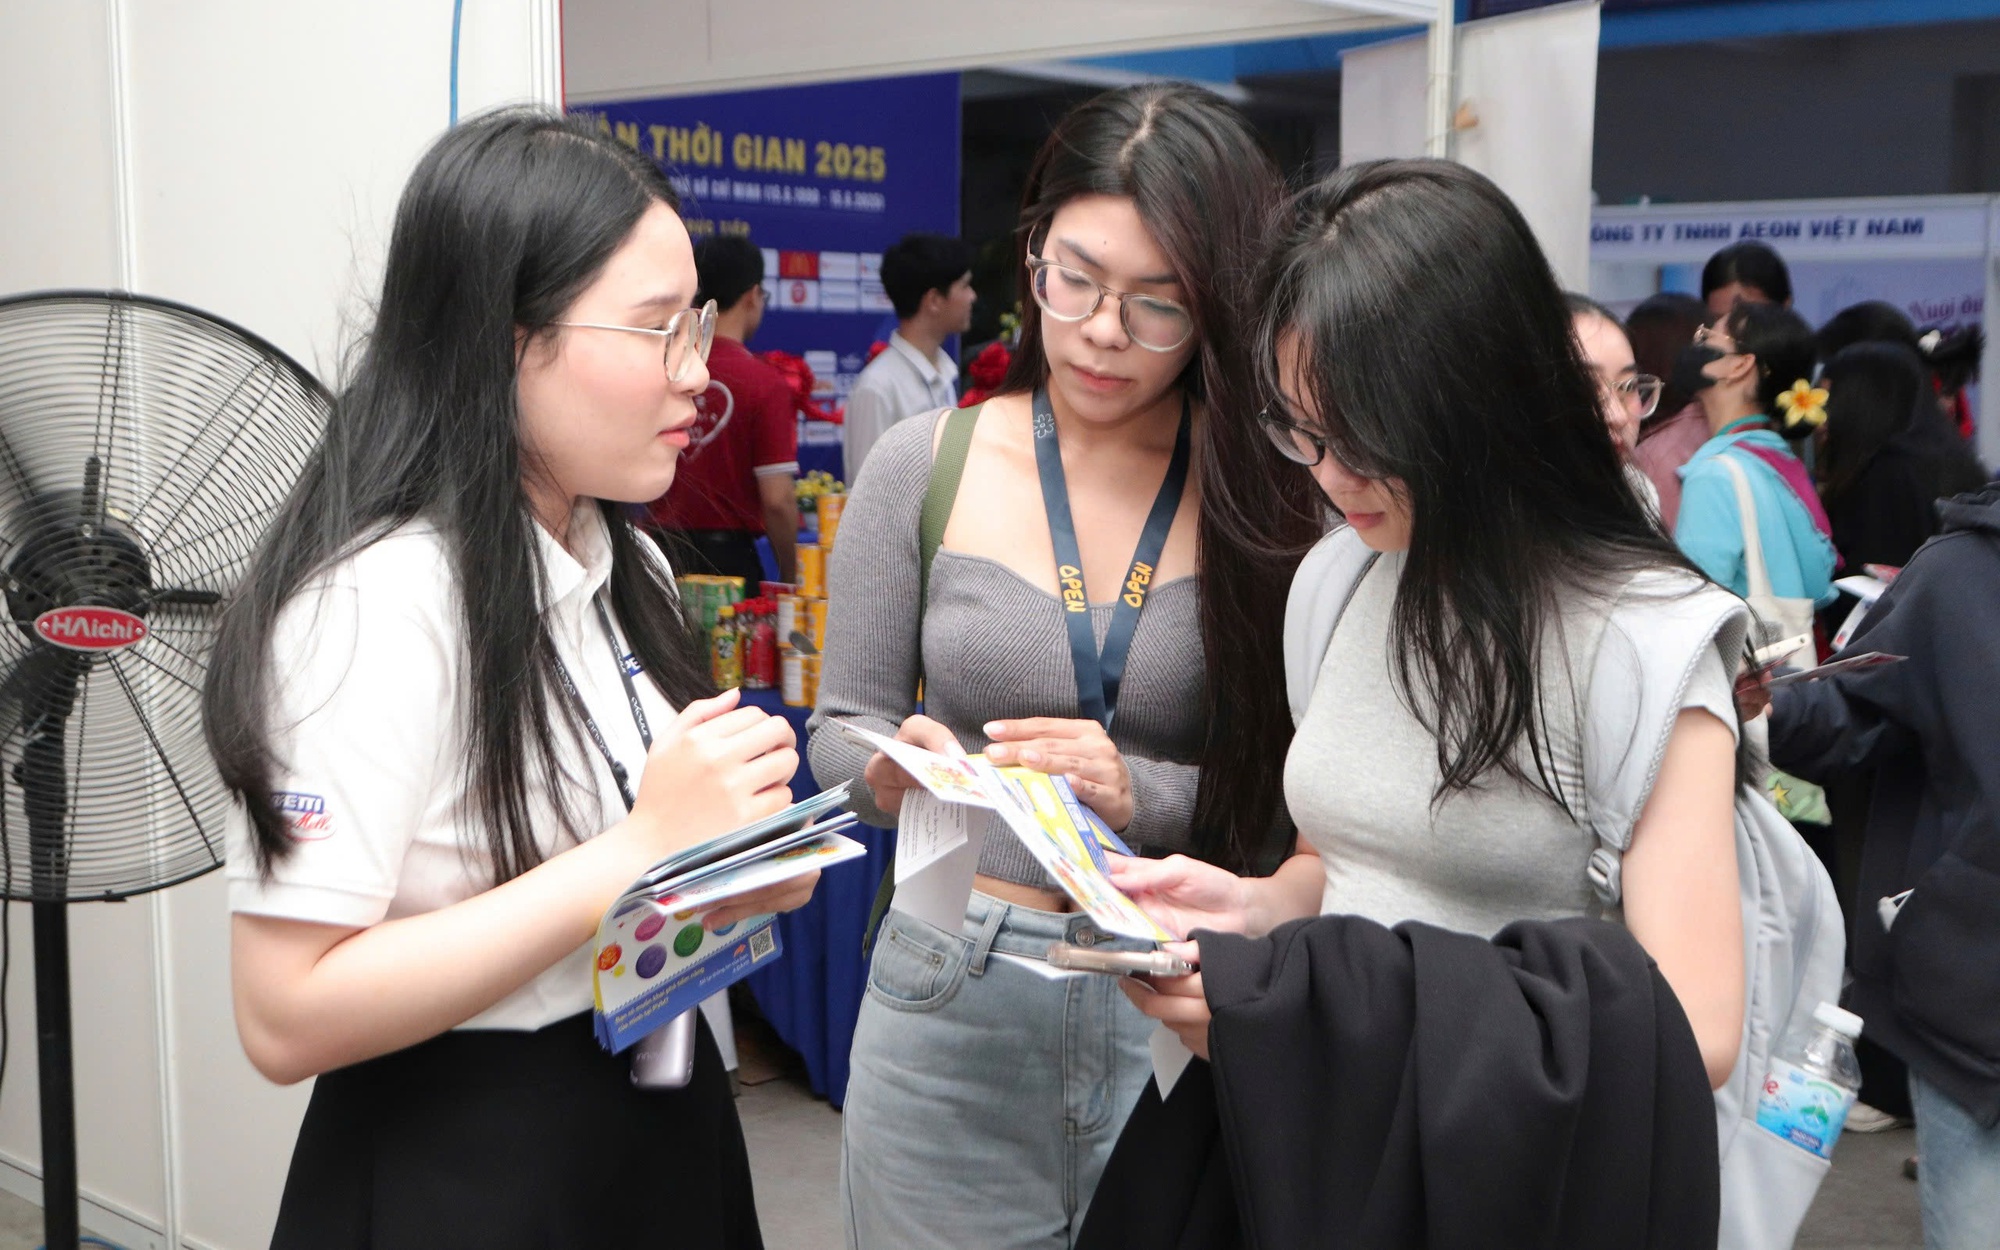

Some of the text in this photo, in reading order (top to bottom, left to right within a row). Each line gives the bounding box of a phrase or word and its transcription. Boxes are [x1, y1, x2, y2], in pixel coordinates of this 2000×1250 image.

[649, 121, 722, 166] THỜI
[733, 133, 806, 176] GIAN
[815, 142, 886, 182] 2025
[1590, 216, 1924, 242] ÔNG TY TNHH AEON VIỆT NAM
[1058, 564, 1088, 613] OPEN
[1123, 561, 1155, 609] OPEN
